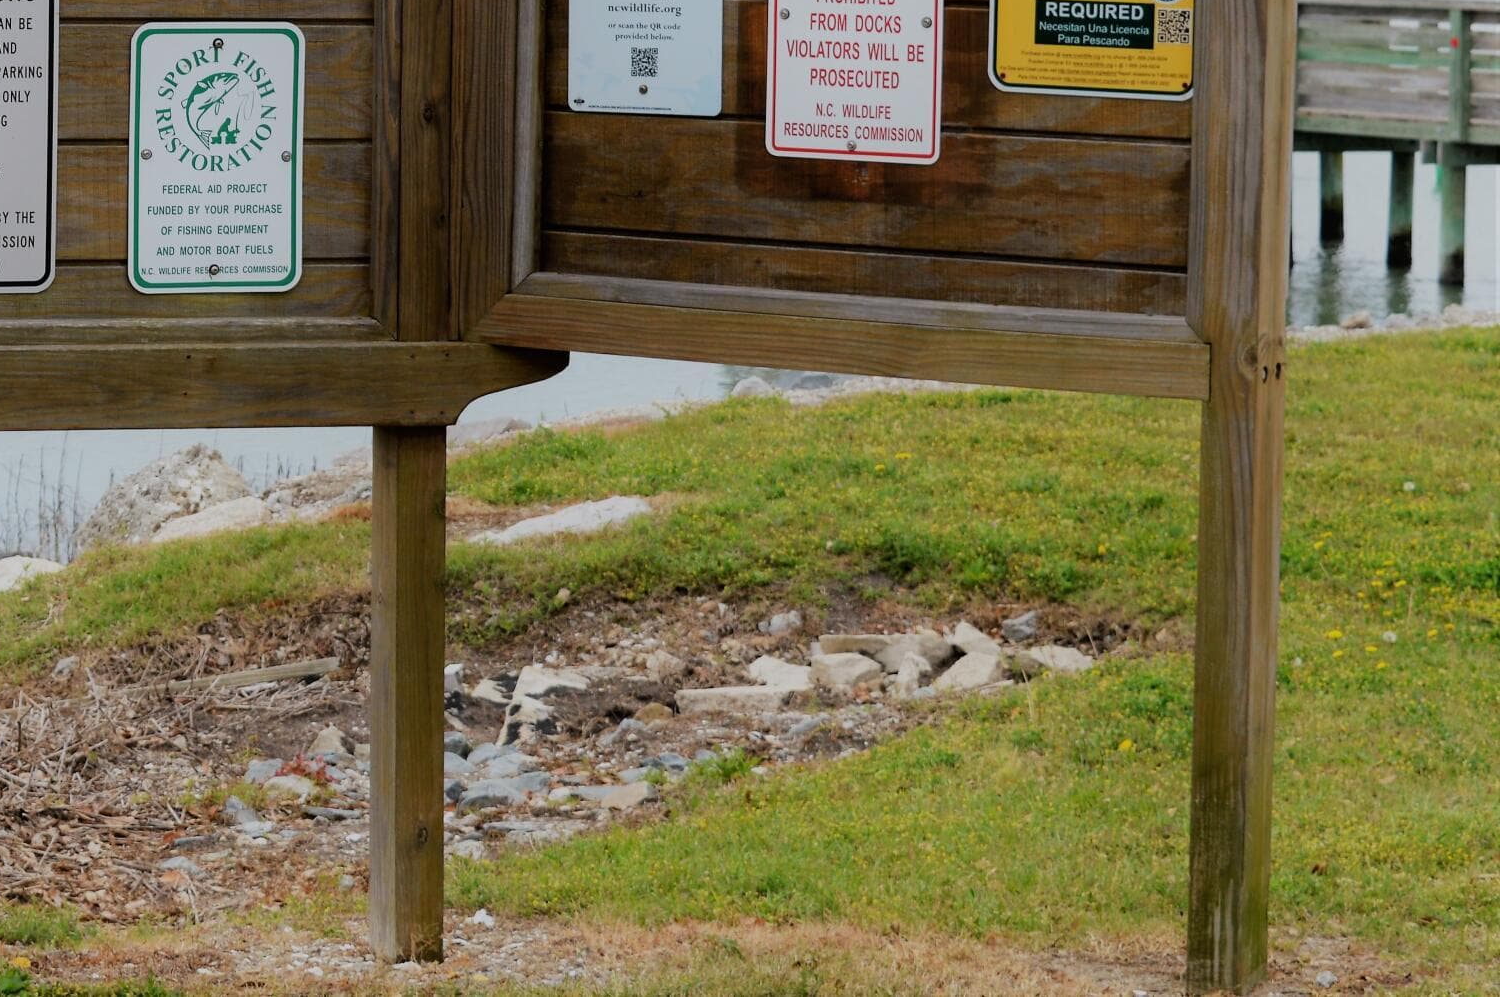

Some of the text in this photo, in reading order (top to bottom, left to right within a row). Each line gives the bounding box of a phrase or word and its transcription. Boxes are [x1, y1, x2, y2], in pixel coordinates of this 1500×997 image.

[608, 4, 681, 16] ncwildlife.org
[1045, 2, 1144, 20] REQUIRED
[19, 18, 32, 31] BE
[810, 13, 901, 34] FROM DOCKS
[1039, 22, 1149, 35] Necesitan Una Licencia
[615, 33, 648, 41] provided
[1058, 34, 1130, 47] Para Pescando
[786, 40, 924, 62] VIOLATORS WILL BE
[157, 46, 275, 100] SPORT FISH
[810, 68, 899, 89] PROSECUTED
[2, 91, 31, 103] ONLY
[816, 104, 891, 120] N.C. WILDLIFE
[155, 104, 276, 172] RESTORATION
[784, 123, 923, 142] RESOURCES COMMISSION
[162, 183, 268, 194] FEDERAL AID PROJECT
[147, 204, 282, 216] FUNDED BY YOUR PURCHASE
[15, 212, 35, 226] THE
[161, 224, 268, 236] OF FISHING EQUIPMENT
[157, 244, 273, 256] AND MOTOR BOAT FUELS
[141, 267, 155, 275] N.C.
[243, 265, 288, 274] COMMISSION
